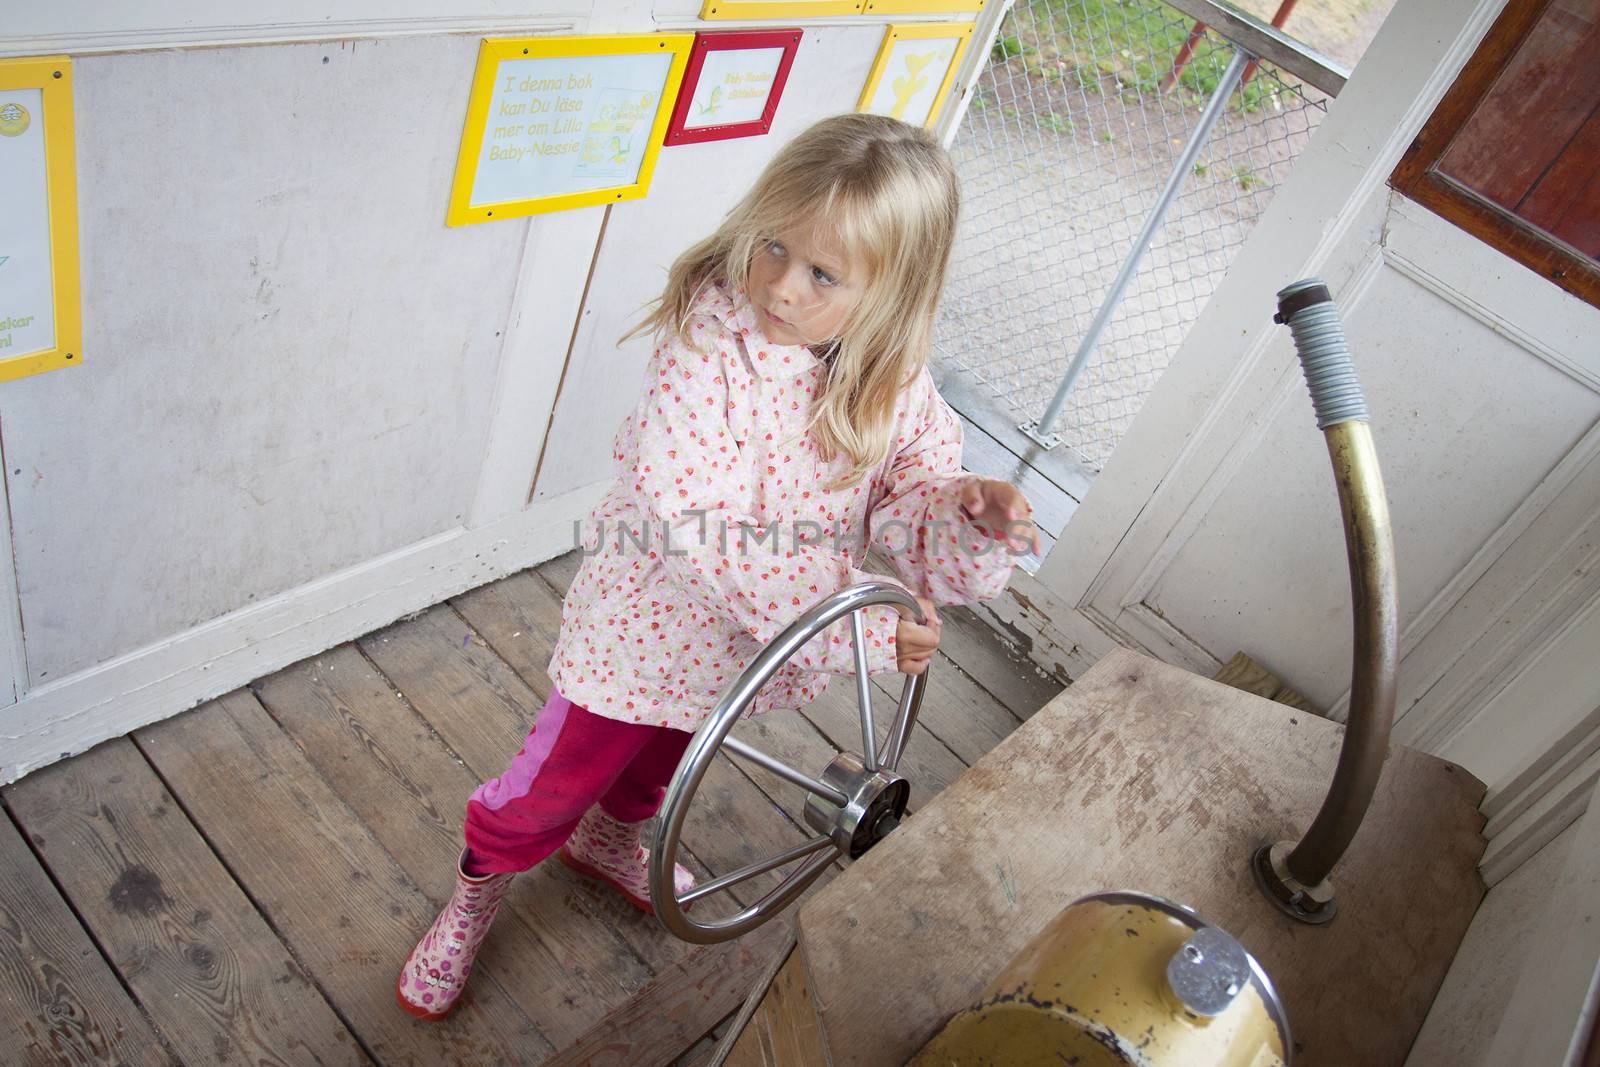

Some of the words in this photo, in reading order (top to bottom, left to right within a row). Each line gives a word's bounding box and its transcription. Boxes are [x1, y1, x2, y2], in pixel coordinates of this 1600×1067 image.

[503, 75, 516, 93] I
[519, 74, 563, 92] denna
[567, 73, 593, 91] bok
[499, 100, 528, 116] kan
[530, 98, 550, 114] Du
[554, 96, 583, 113] läsa
[493, 124, 525, 139] mer
[527, 123, 549, 136] om
[552, 117, 583, 134] Lilla
[489, 140, 580, 163] Baby-Nessie
